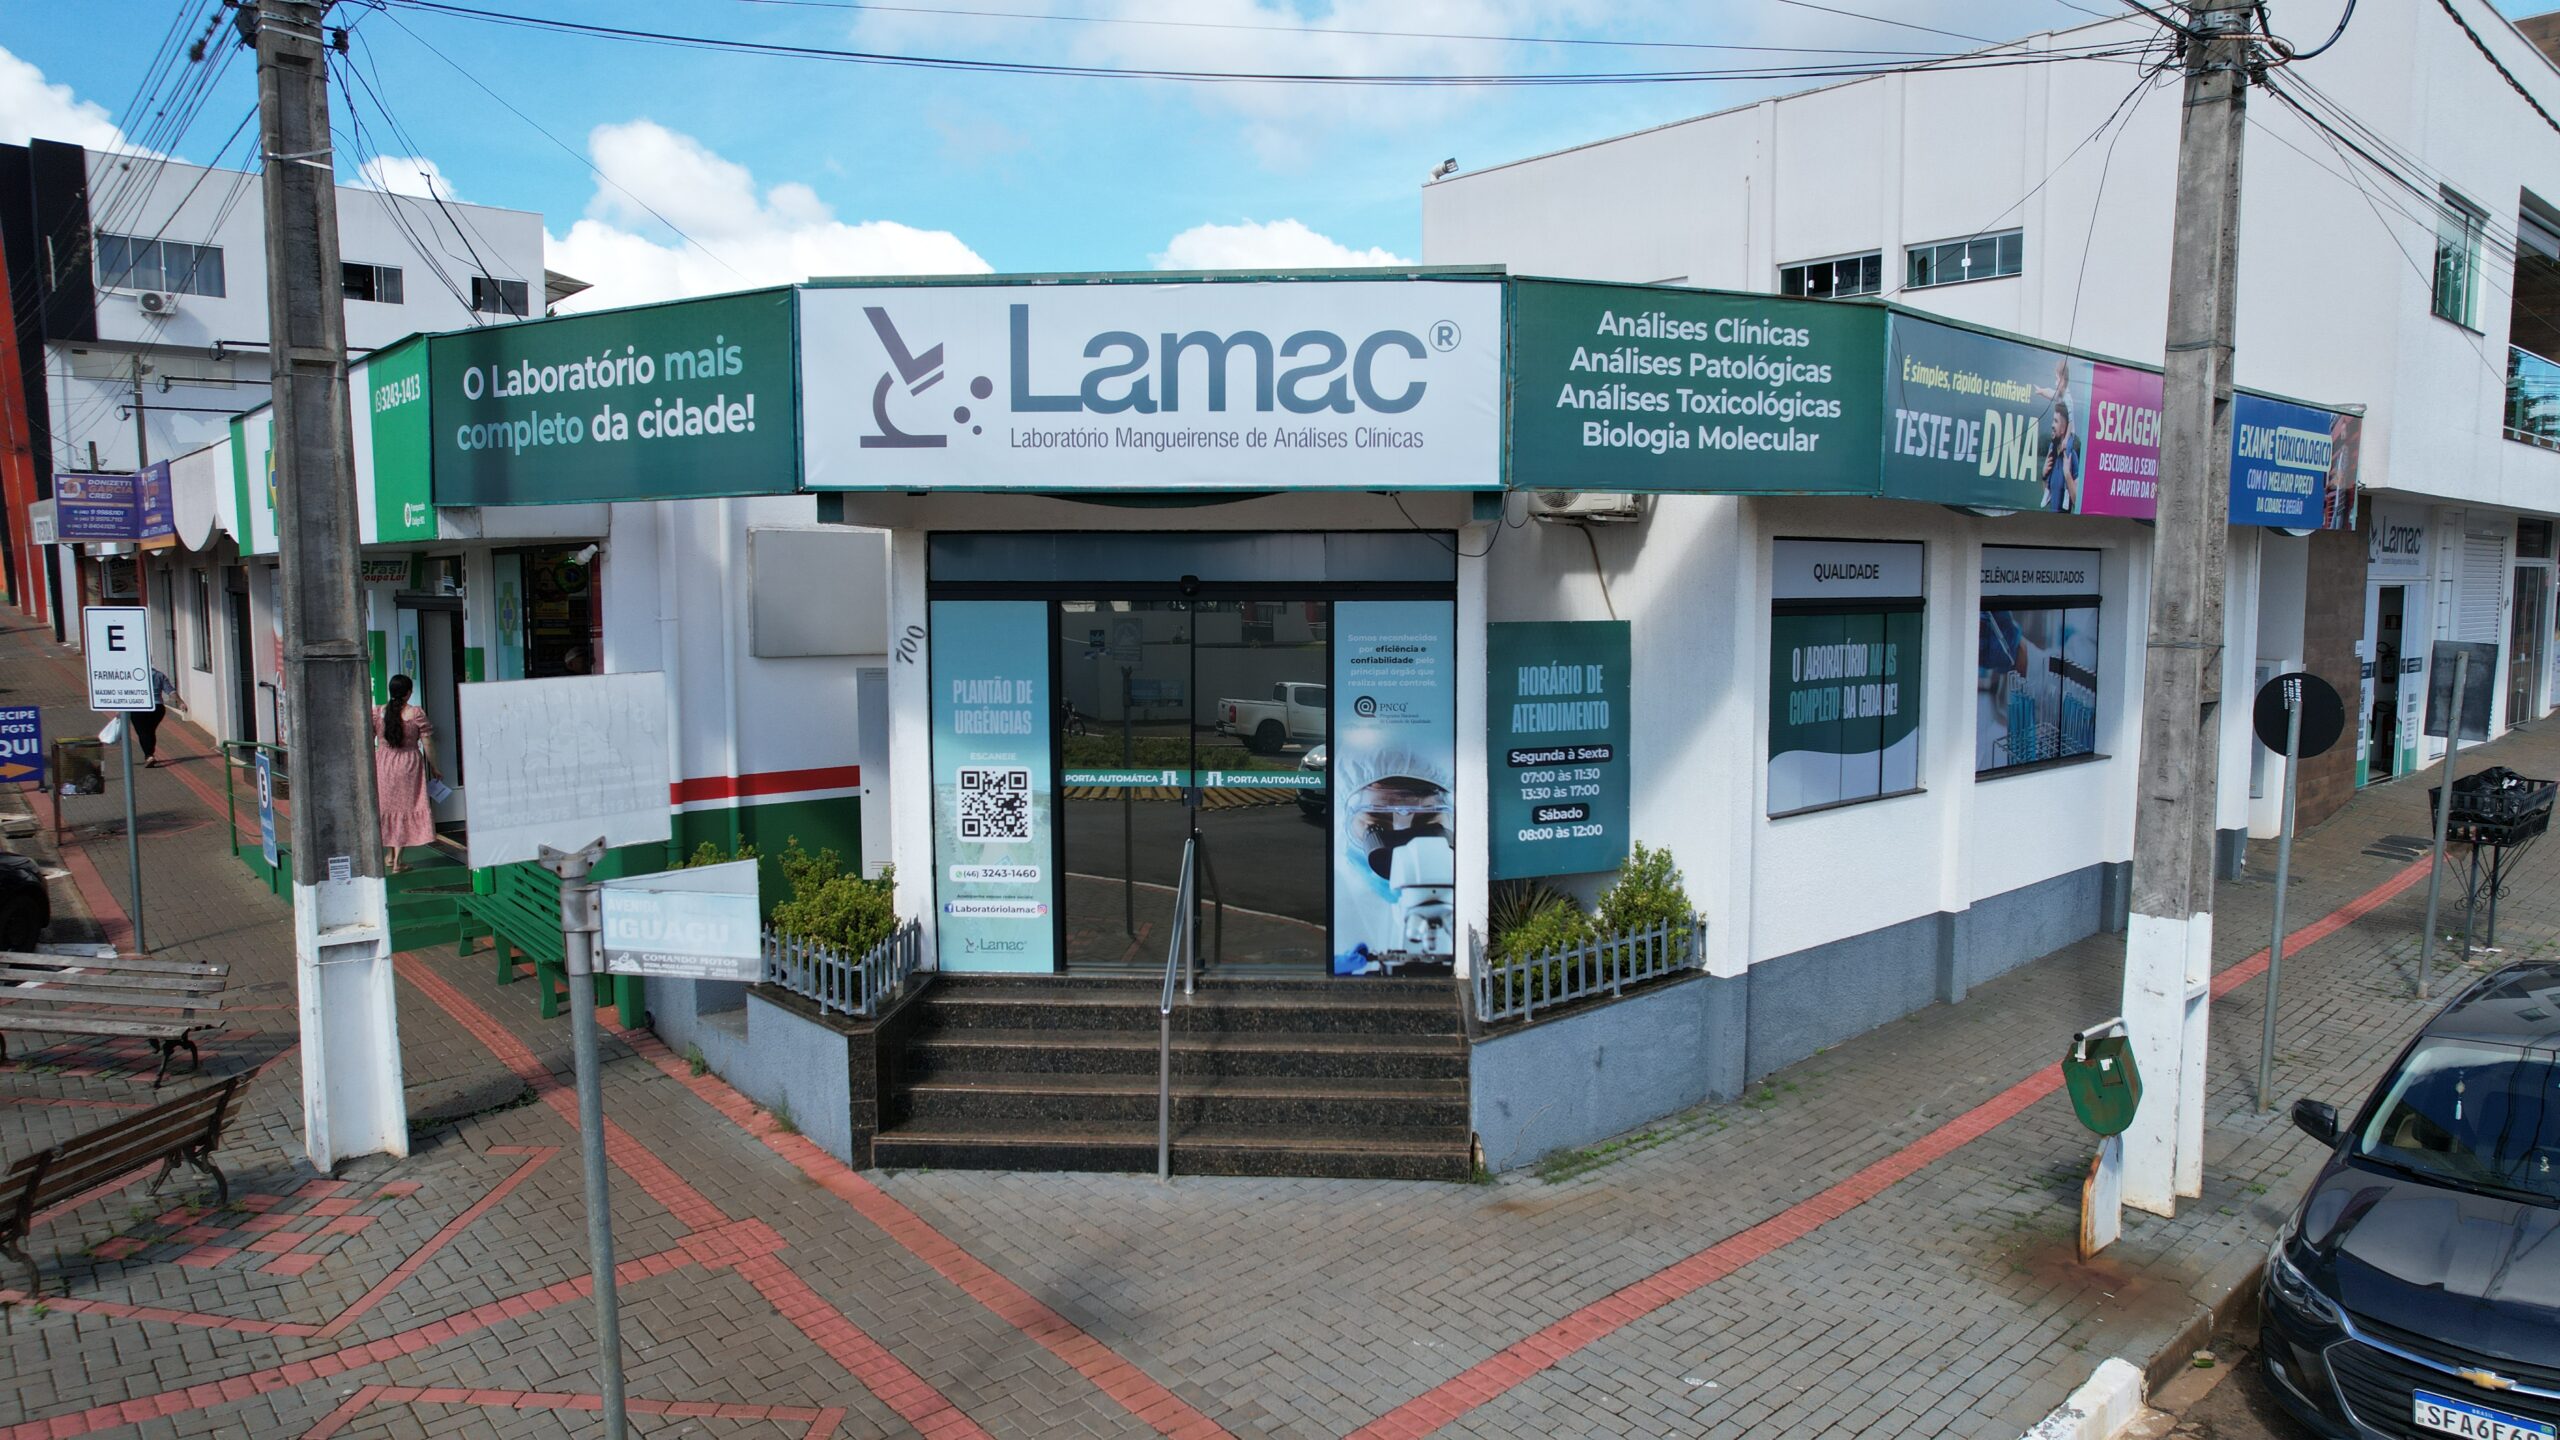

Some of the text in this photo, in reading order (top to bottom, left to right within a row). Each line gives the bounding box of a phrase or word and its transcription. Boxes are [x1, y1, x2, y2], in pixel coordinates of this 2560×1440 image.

[1597, 310, 1810, 347] Análises Clínicas
[463, 335, 743, 400] O Laboratório mais
[1569, 346, 1832, 386] Análises Patológicas
[1903, 354, 2032, 403] É simples, rápido e confiável!
[380, 372, 421, 412] 3243-1413
[1556, 383, 1841, 422] Análises Toxicológicas
[456, 393, 756, 455] completo da cidade!
[2095, 400, 2162, 448] SEXAGEM
[1010, 427, 1424, 453] Laboratório Mangueirense de Análises Clínicas
[1583, 421, 1819, 455] Biologia Molecular
[1894, 408, 2039, 482] TESTE DE DNA
[2238, 424, 2276, 460] EXAME
[2099, 453, 2134, 473] DESCUBRA
[2134, 457, 2139, 474] O
[2140, 458, 2156, 476] SEXO
[88, 486, 134, 494] GARCIA
[2110, 478, 2116, 496] A
[2117, 479, 2140, 497] PARTIR
[2140, 481, 2149, 498] DA
[2246, 468, 2314, 498] COM O MELHOR PREÇO
[2256, 496, 2264, 512] DA
[2264, 497, 2282, 513] CIDADE
[2282, 498, 2286, 514] E
[2382, 515, 2422, 555] Lamac
[361, 560, 409, 574] Brasil
[1813, 562, 1880, 582] QUALIDADE
[1981, 566, 2085, 584] CELÊNCIA EM RESULTADOS
[363, 574, 389, 584] oupa
[107, 624, 127, 651] E
[895, 625, 926, 665] 700
[1348, 634, 1437, 642] Somos reconhecidos
[1375, 645, 1418, 653] eficiência
[1350, 656, 1414, 664] confiabilidade
[1792, 647, 1801, 682] O
[1803, 637, 1868, 681] LABORATÓRIO
[1350, 667, 1389, 676] principal
[1518, 660, 1603, 696] HORÁRIO DE
[953, 676, 1033, 704] PLANTÃO DE
[1380, 702, 1407, 712] PNCQ
[1789, 686, 1841, 726] COMPLETO
[1843, 685, 1857, 720] DA
[0, 710, 36, 721] ECIPE
[954, 707, 1032, 735] URGÊNCIAS
[1511, 700, 1610, 733] ATENDIMENTO
[1, 724, 35, 734] FGTS
[0, 738, 39, 758] QUI
[969, 752, 1017, 761] ESCANEIE
[1511, 747, 1609, 765] Segunda à Sexta
[1064, 772, 1158, 783] PORTA AUTOMÁTICA
[1227, 774, 1321, 785] PORTA AUTOMÁTICA
[1521, 768, 1600, 784] 07:00 às 11:30
[1521, 783, 1600, 800] 13:30 às 17:00
[1538, 806, 1583, 821] Sábado
[1518, 824, 1603, 842] 08:00 às 12:00
[963, 868, 1037, 879] (46) 3243-1460
[607, 898, 660, 914] AVENIDA
[955, 904, 1036, 914] Laboratóriolamac
[980, 937, 1025, 951] Lamac
[642, 953, 697, 964] COMANDO
[700, 957, 739, 967] MOTOS
[2471, 1408, 2495, 1419] BRASIL
